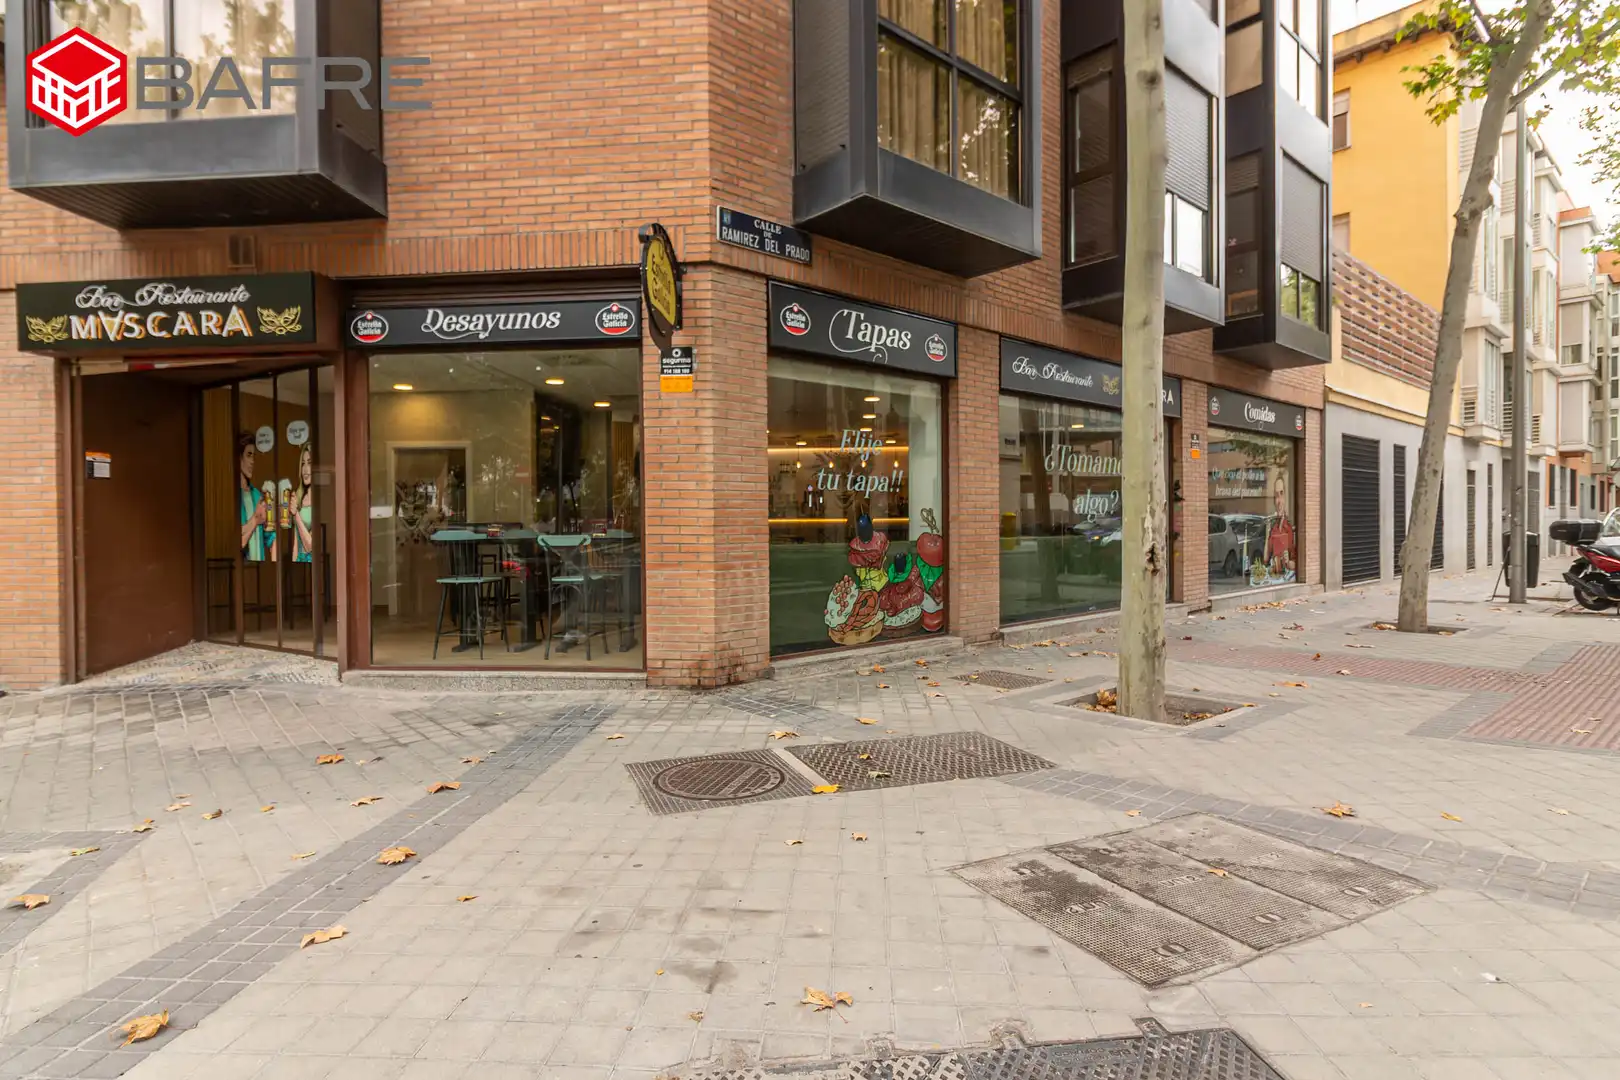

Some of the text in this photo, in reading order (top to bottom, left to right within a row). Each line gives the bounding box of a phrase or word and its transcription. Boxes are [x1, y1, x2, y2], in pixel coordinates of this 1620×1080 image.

[754, 219, 782, 235] CALLE
[763, 231, 773, 239] DE
[721, 226, 810, 263] RAMIREZ DEL PRADO
[75, 282, 251, 311] Bar Restaurante
[421, 308, 561, 340] Desayunos
[602, 312, 628, 321] Estrella
[602, 319, 627, 328] Galicia
[829, 309, 912, 359] Tapas
[1244, 401, 1276, 426] Comidas
[840, 429, 884, 462] Elije
[1044, 443, 1122, 475] ¿Tomam
[817, 467, 904, 499] tu tapa!!
[1073, 488, 1120, 523] algo?
